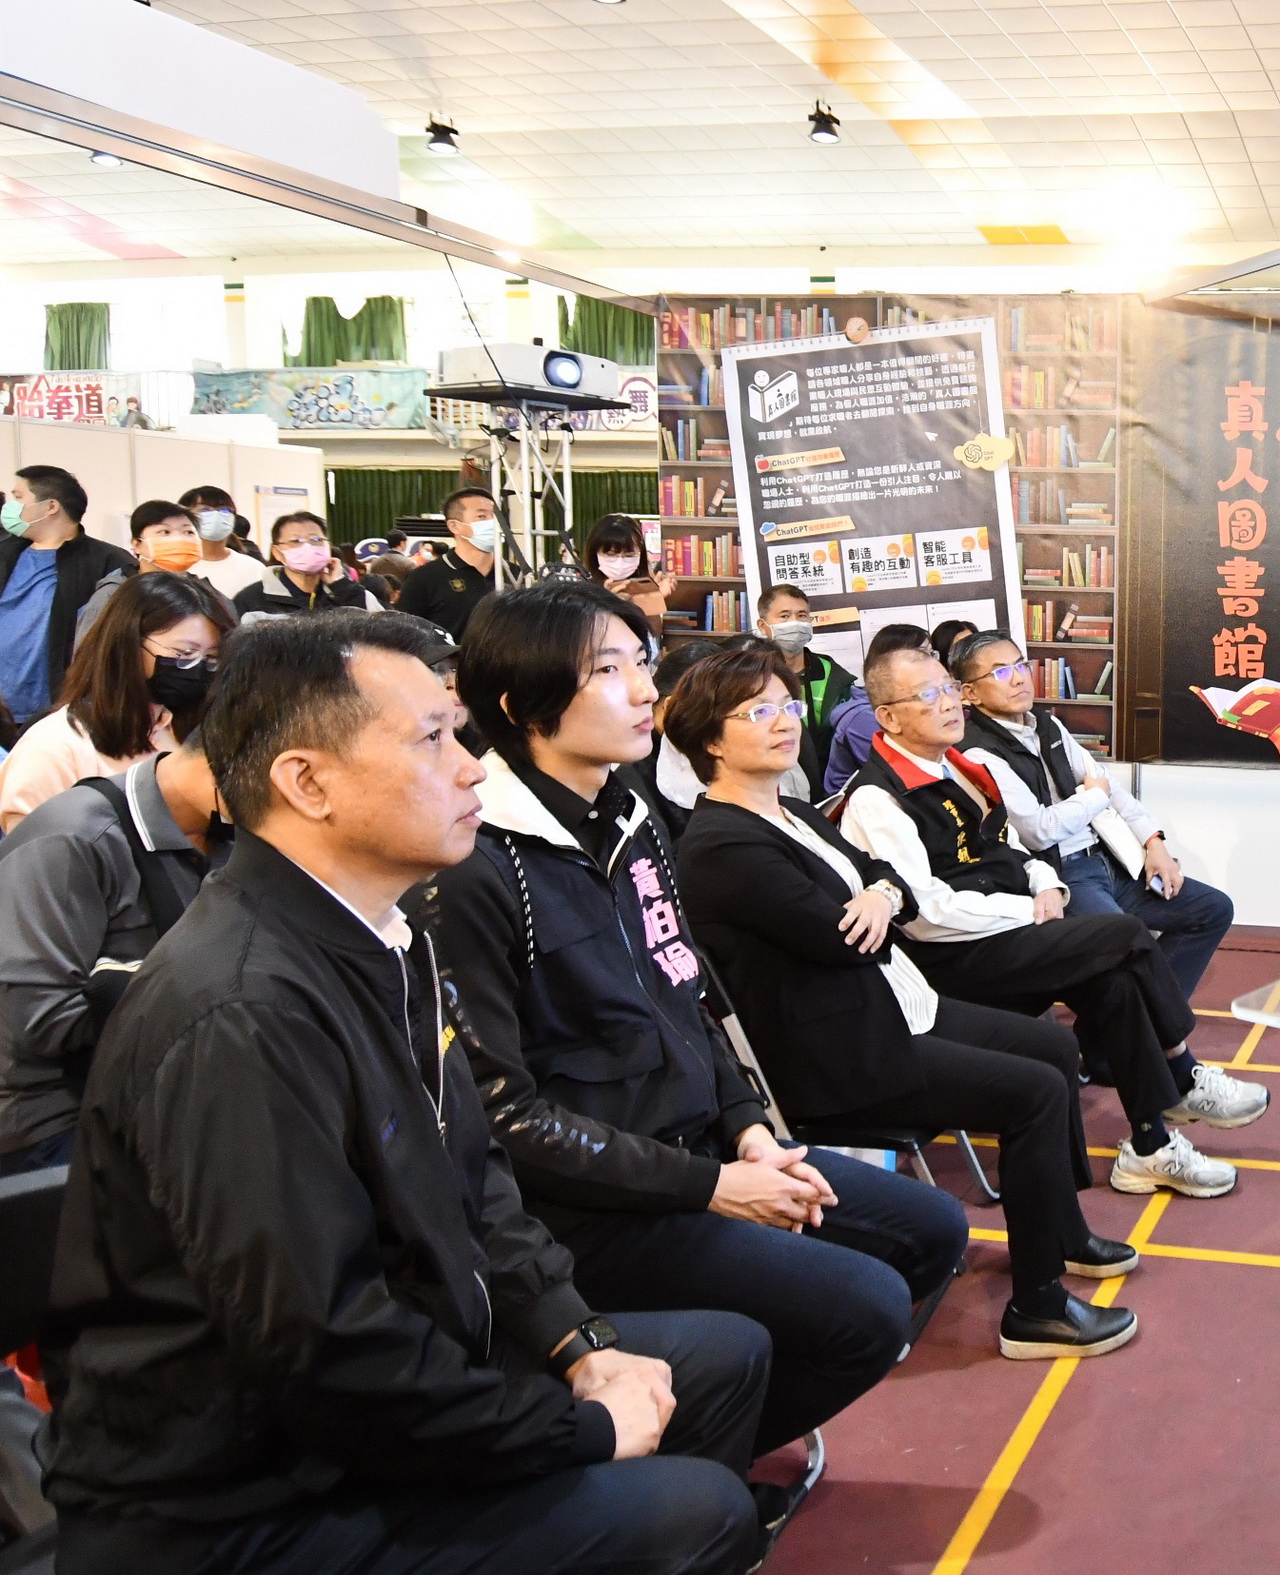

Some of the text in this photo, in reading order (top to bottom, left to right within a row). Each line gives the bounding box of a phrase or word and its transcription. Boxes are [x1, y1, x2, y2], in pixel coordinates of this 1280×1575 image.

[1212, 381, 1269, 679] 真人圖書館
[848, 547, 872, 561] 創造
[922, 540, 946, 553] 智能
[774, 552, 810, 567] 自助型
[850, 556, 911, 574] 有趣的互動
[924, 551, 973, 567] 客服工具
[776, 565, 825, 580] 問答系統
